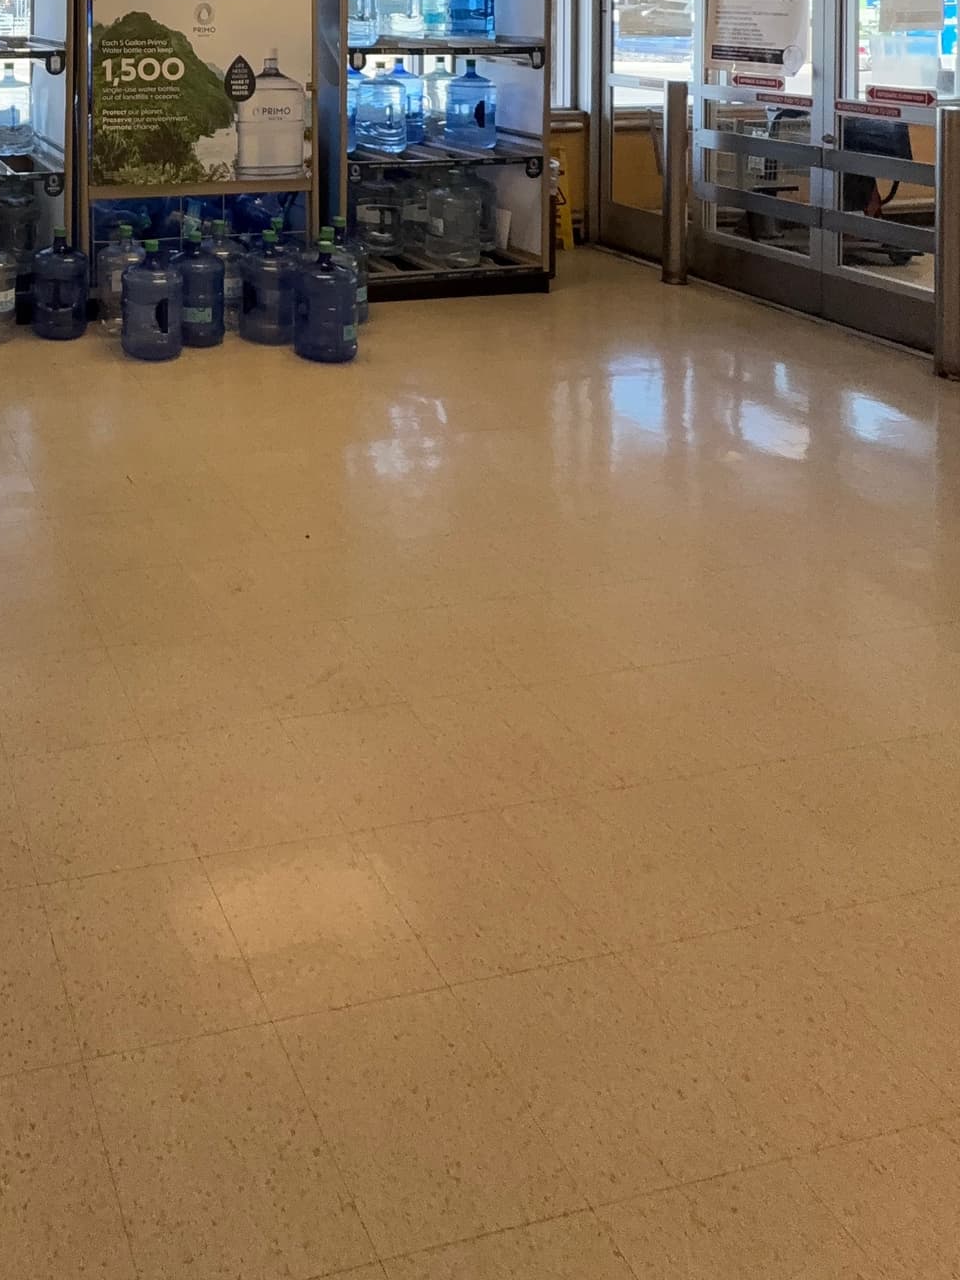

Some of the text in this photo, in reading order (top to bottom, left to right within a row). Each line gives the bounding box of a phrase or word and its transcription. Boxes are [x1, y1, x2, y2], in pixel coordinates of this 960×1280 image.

[125, 39, 146, 47] Gallon
[101, 57, 185, 87] 1,500
[262, 107, 291, 115] PRIMO
